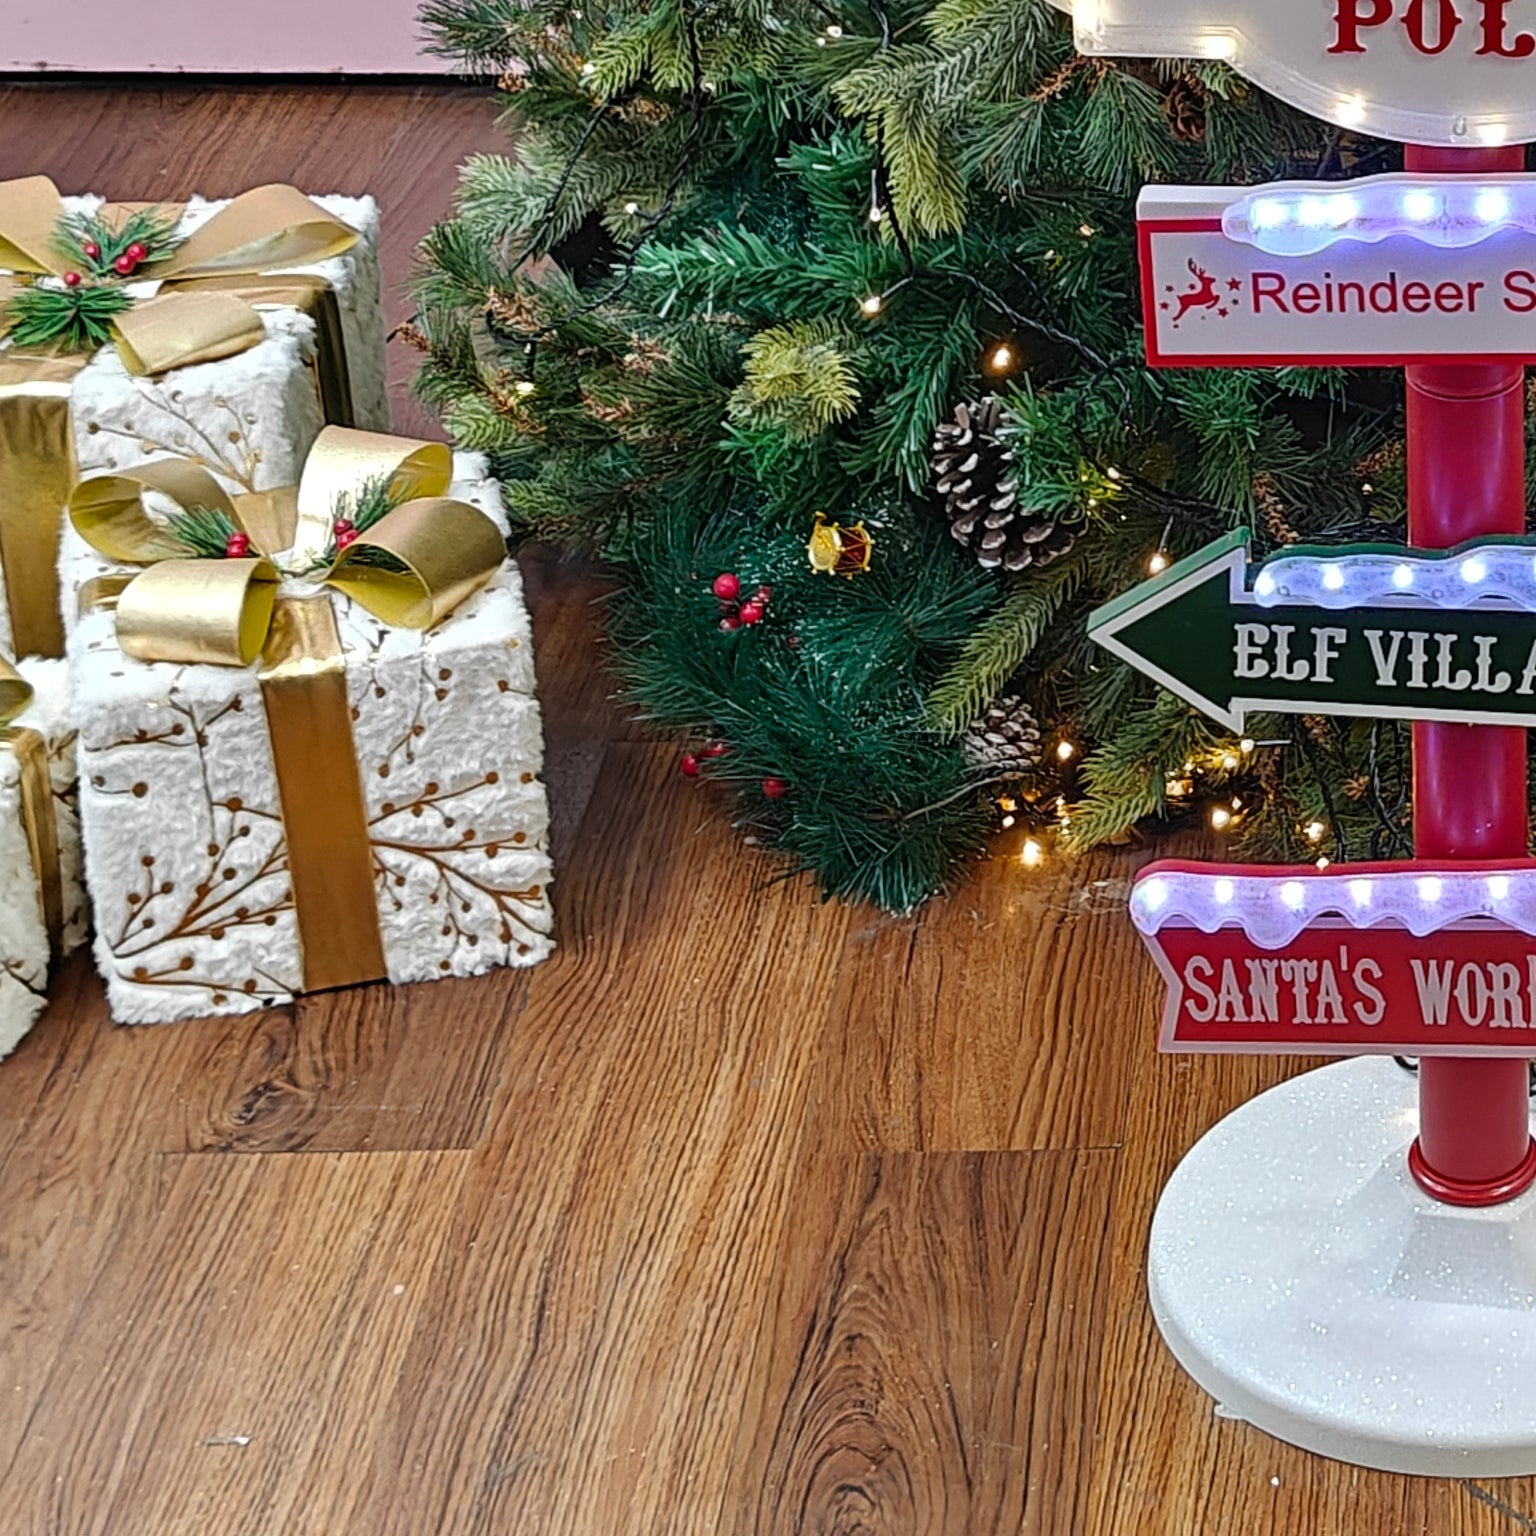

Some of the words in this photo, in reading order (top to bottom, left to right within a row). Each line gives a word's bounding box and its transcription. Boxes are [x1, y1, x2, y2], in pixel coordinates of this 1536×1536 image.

[1251, 272, 1483, 314] Reindeer
[1232, 623, 1347, 682] ELF
[1184, 945, 1386, 1025] SANTA'S
